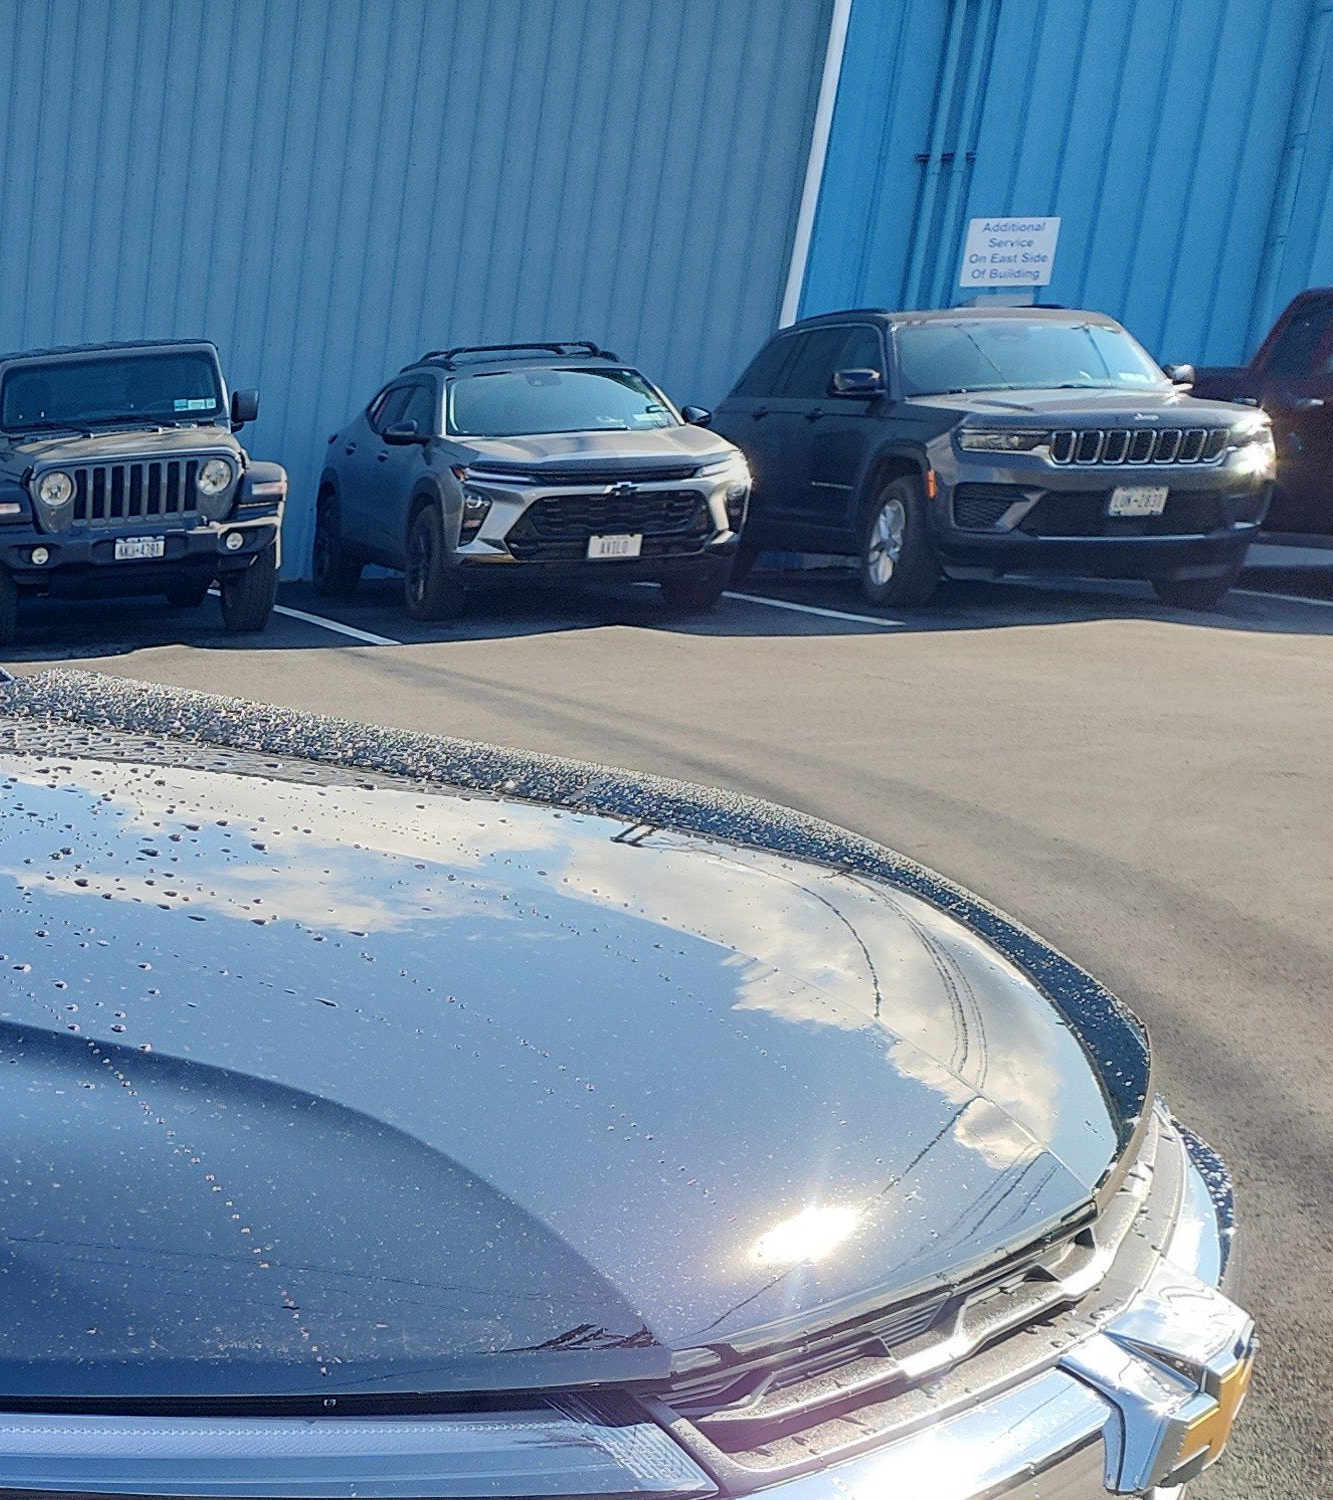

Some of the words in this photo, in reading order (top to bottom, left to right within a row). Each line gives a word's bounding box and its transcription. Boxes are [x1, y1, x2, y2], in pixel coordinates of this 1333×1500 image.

[982, 222, 1046, 232] Additional
[988, 237, 1033, 248] Service
[969, 253, 986, 263] On
[991, 253, 1017, 263] East
[1021, 252, 1048, 263] Side
[971, 269, 987, 279] Of
[989, 268, 1040, 281] Building
